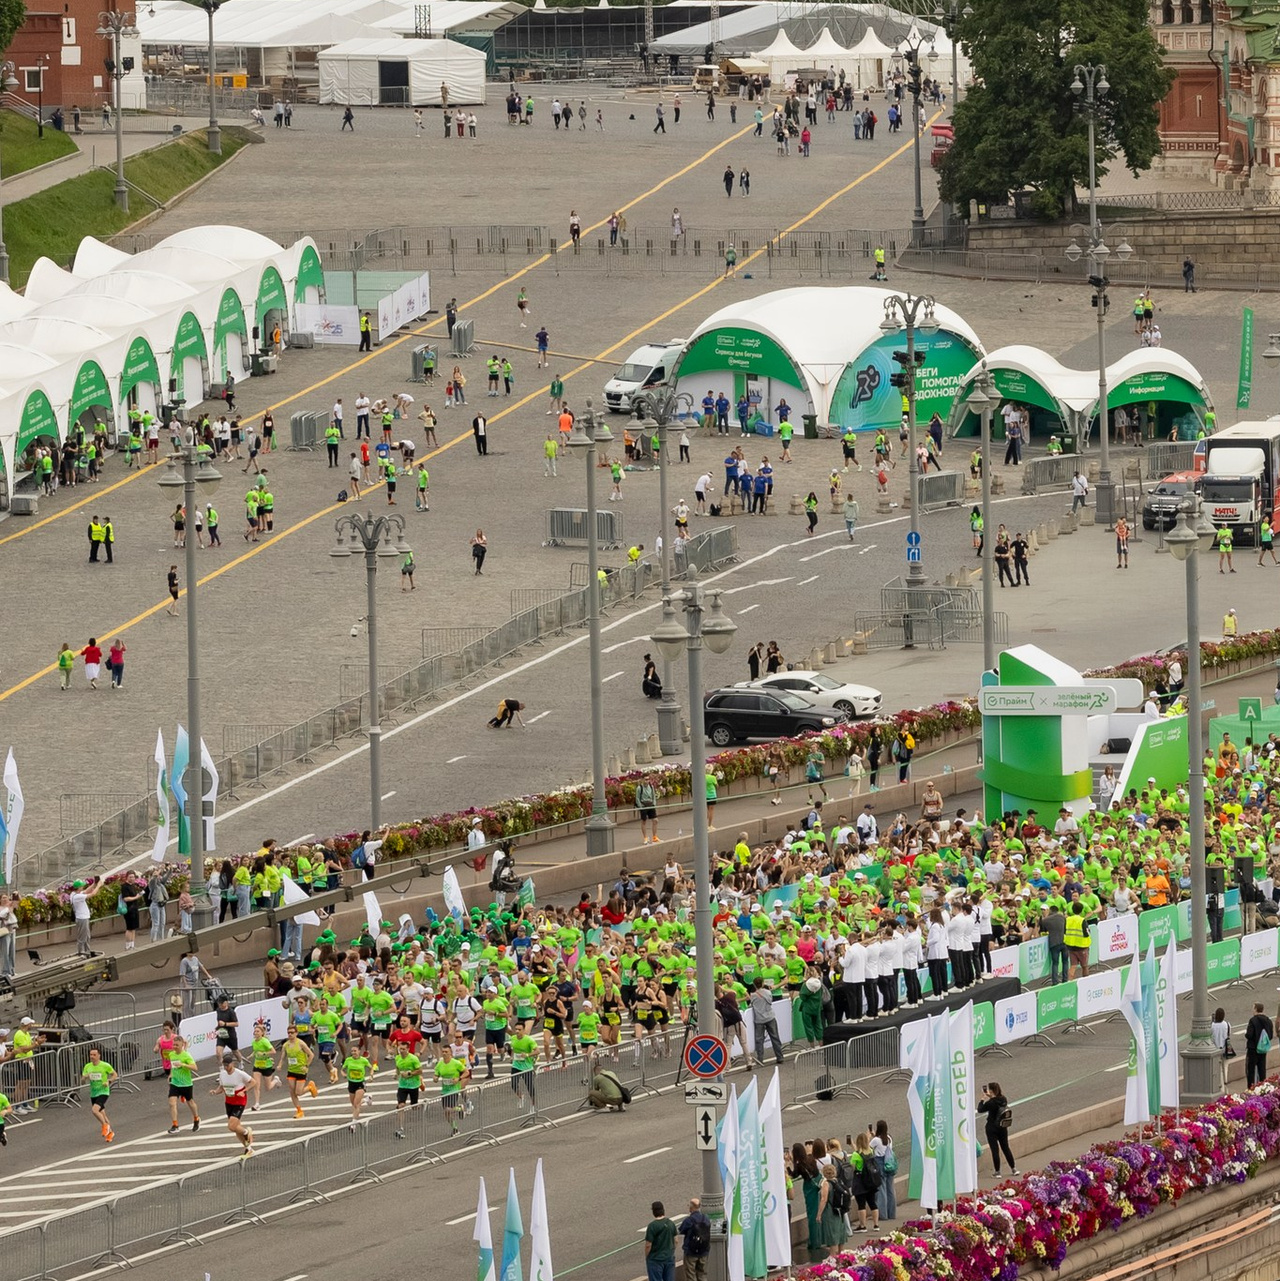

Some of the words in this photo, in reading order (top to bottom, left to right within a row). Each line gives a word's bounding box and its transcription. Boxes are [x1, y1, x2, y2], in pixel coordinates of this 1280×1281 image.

[715, 348, 735, 356] Сервисы
[916, 368, 938, 378] БЕГИ
[1129, 385, 1165, 395] Информация
[999, 696, 1028, 706] Прайм
[1057, 692, 1092, 701] зелёный
[1052, 700, 1089, 710] марафон
[1244, 706, 1257, 719] A
[1092, 989, 1104, 999] СБЕР
[193, 1033, 206, 1045] СБЕР
